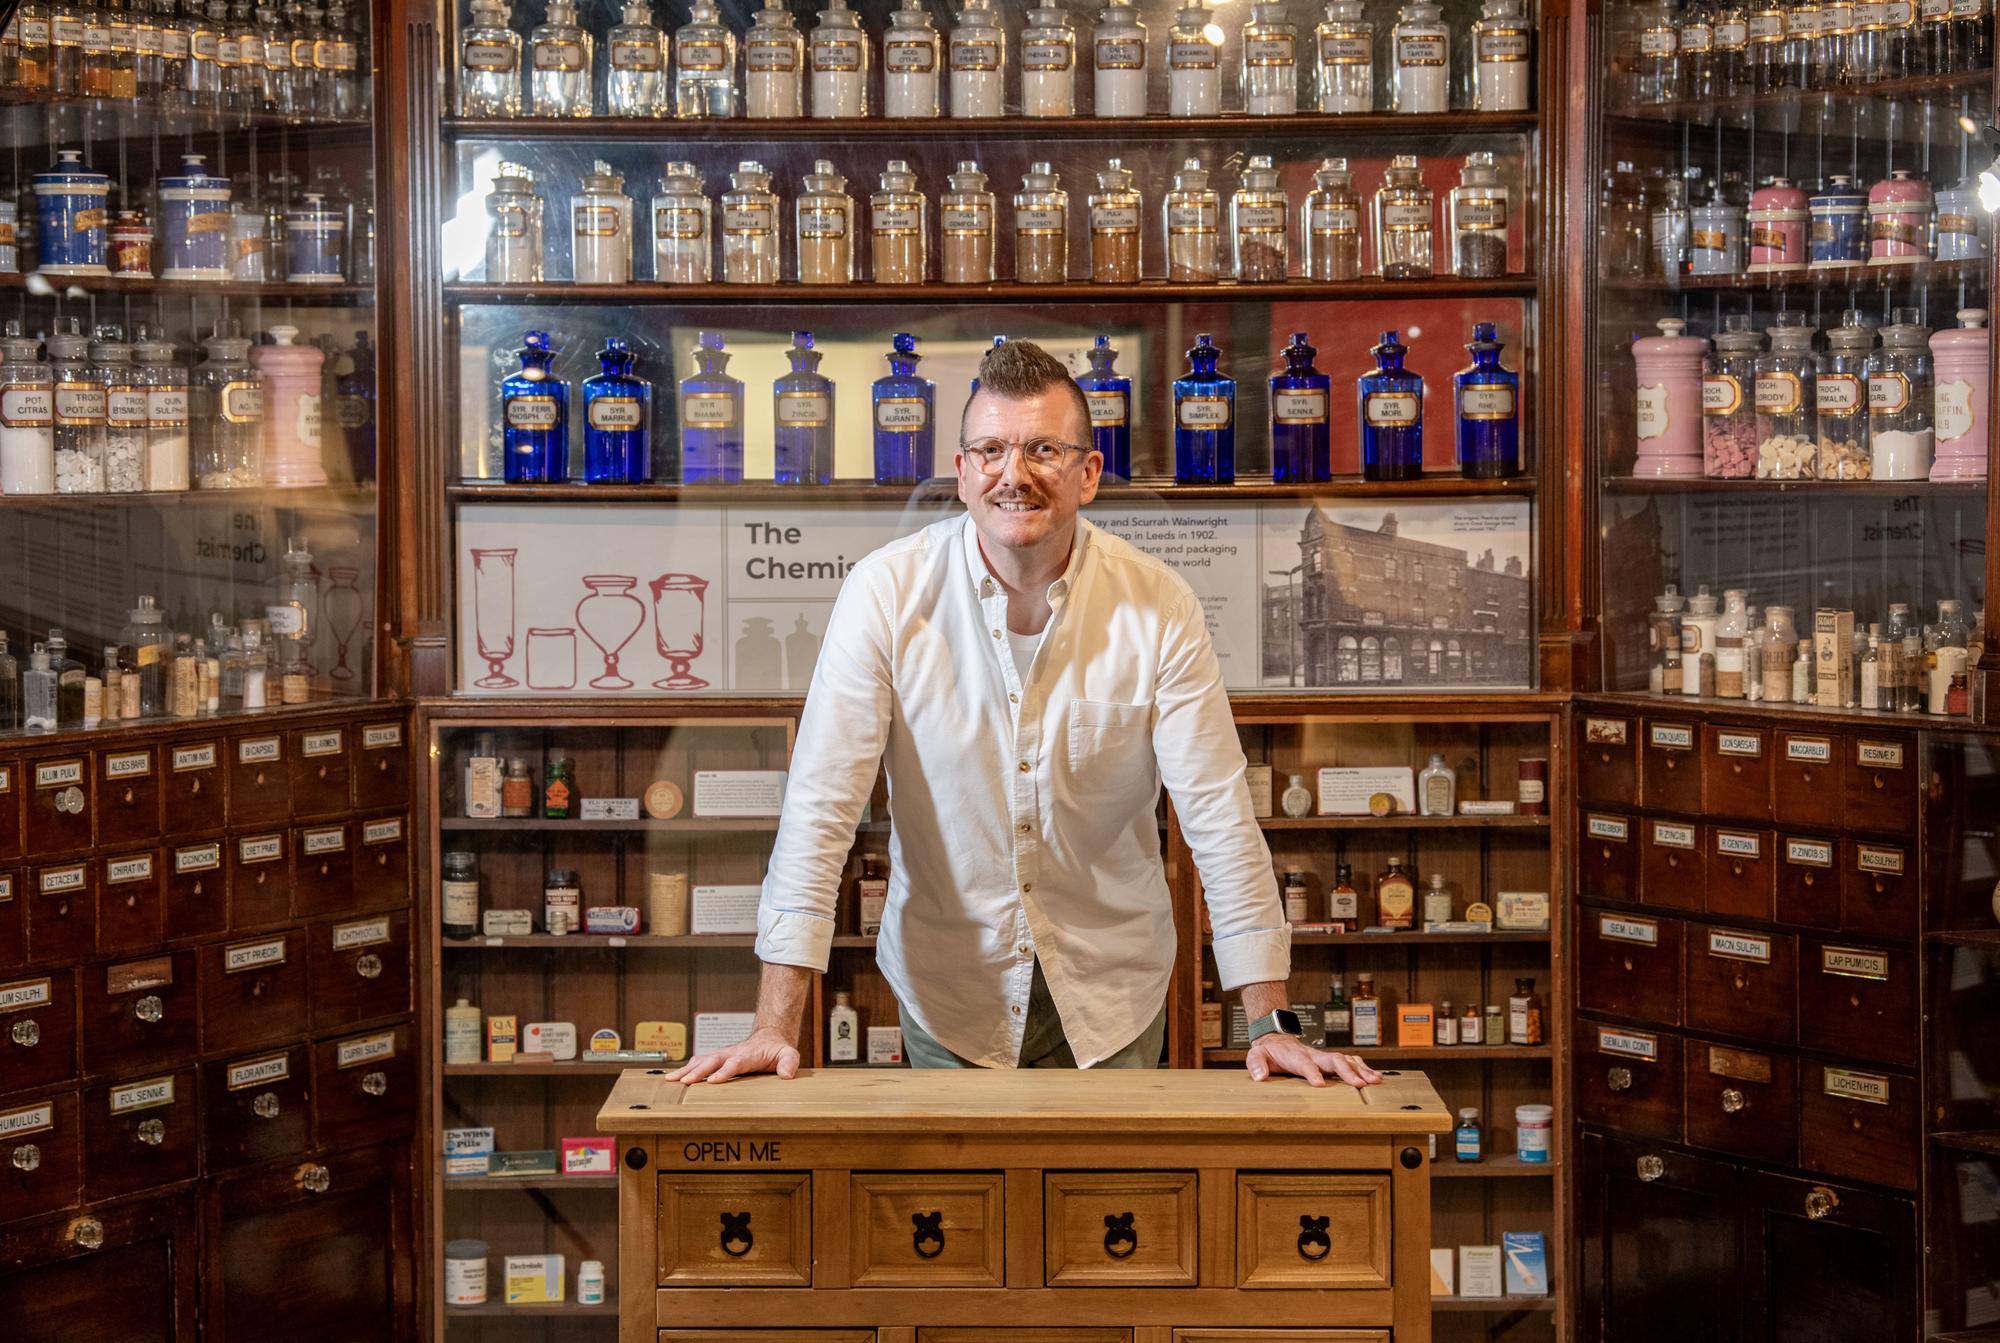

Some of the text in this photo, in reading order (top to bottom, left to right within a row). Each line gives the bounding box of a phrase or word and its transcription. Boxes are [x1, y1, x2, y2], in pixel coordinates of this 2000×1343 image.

[1110, 517, 1129, 527] and
[1131, 517, 1169, 527] Scurrah
[1172, 517, 1228, 530] Wainwright
[744, 521, 802, 546] The
[1134, 531, 1143, 540] in
[1146, 530, 1176, 541] Leeds
[1178, 531, 1187, 540] in
[1191, 530, 1217, 541] 1902.
[1138, 543, 1238, 557] ture and packaging
[1183, 556, 1211, 567] world
[746, 557, 857, 582] Chemis
[46, 871, 80, 888] CETACEUM
[446, 1131, 462, 1140] De
[456, 1139, 481, 1148] Pills
[683, 1142, 782, 1163] OPEN ME
